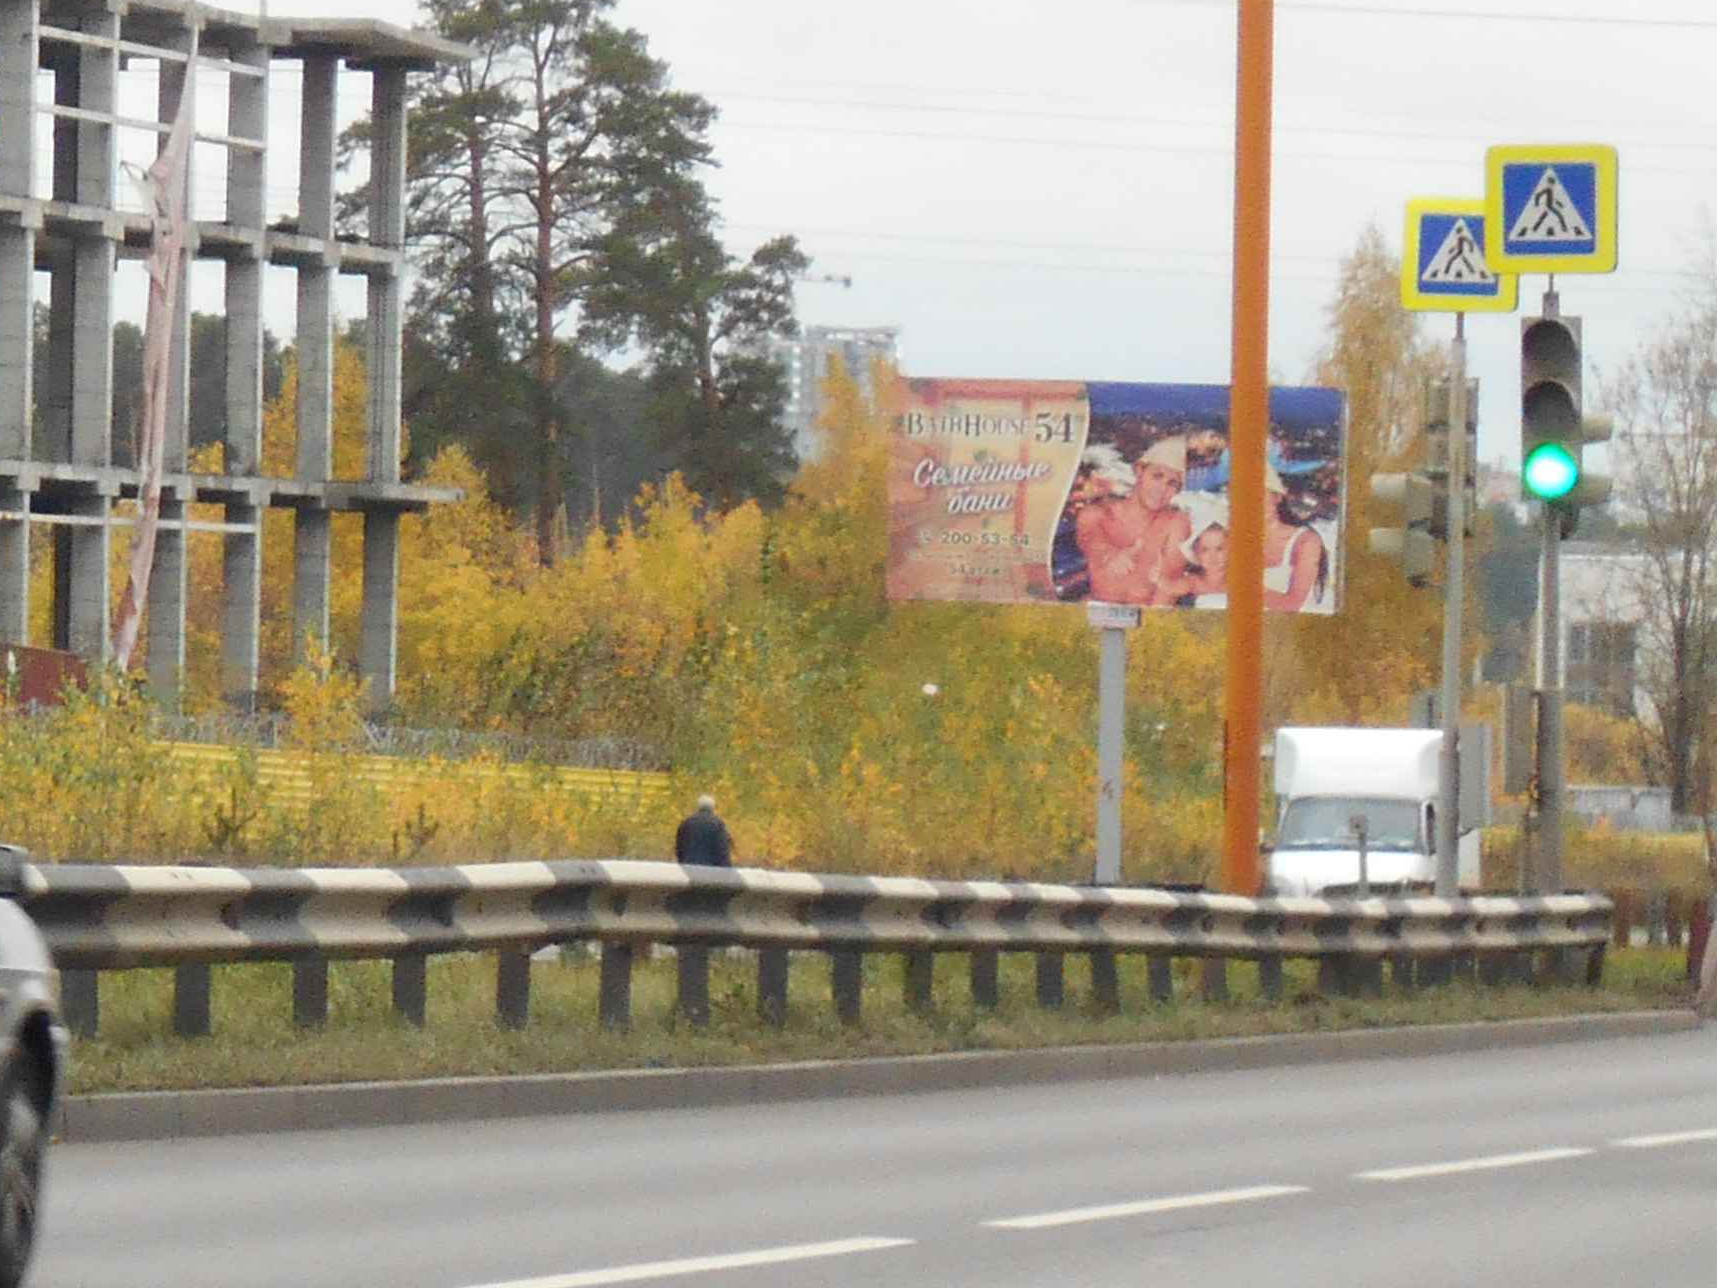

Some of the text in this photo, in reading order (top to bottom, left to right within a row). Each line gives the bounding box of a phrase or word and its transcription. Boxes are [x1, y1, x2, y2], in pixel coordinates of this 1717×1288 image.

[1035, 411, 1075, 444] 54
[914, 457, 1049, 489] Семейные
[947, 486, 1014, 514] бани
